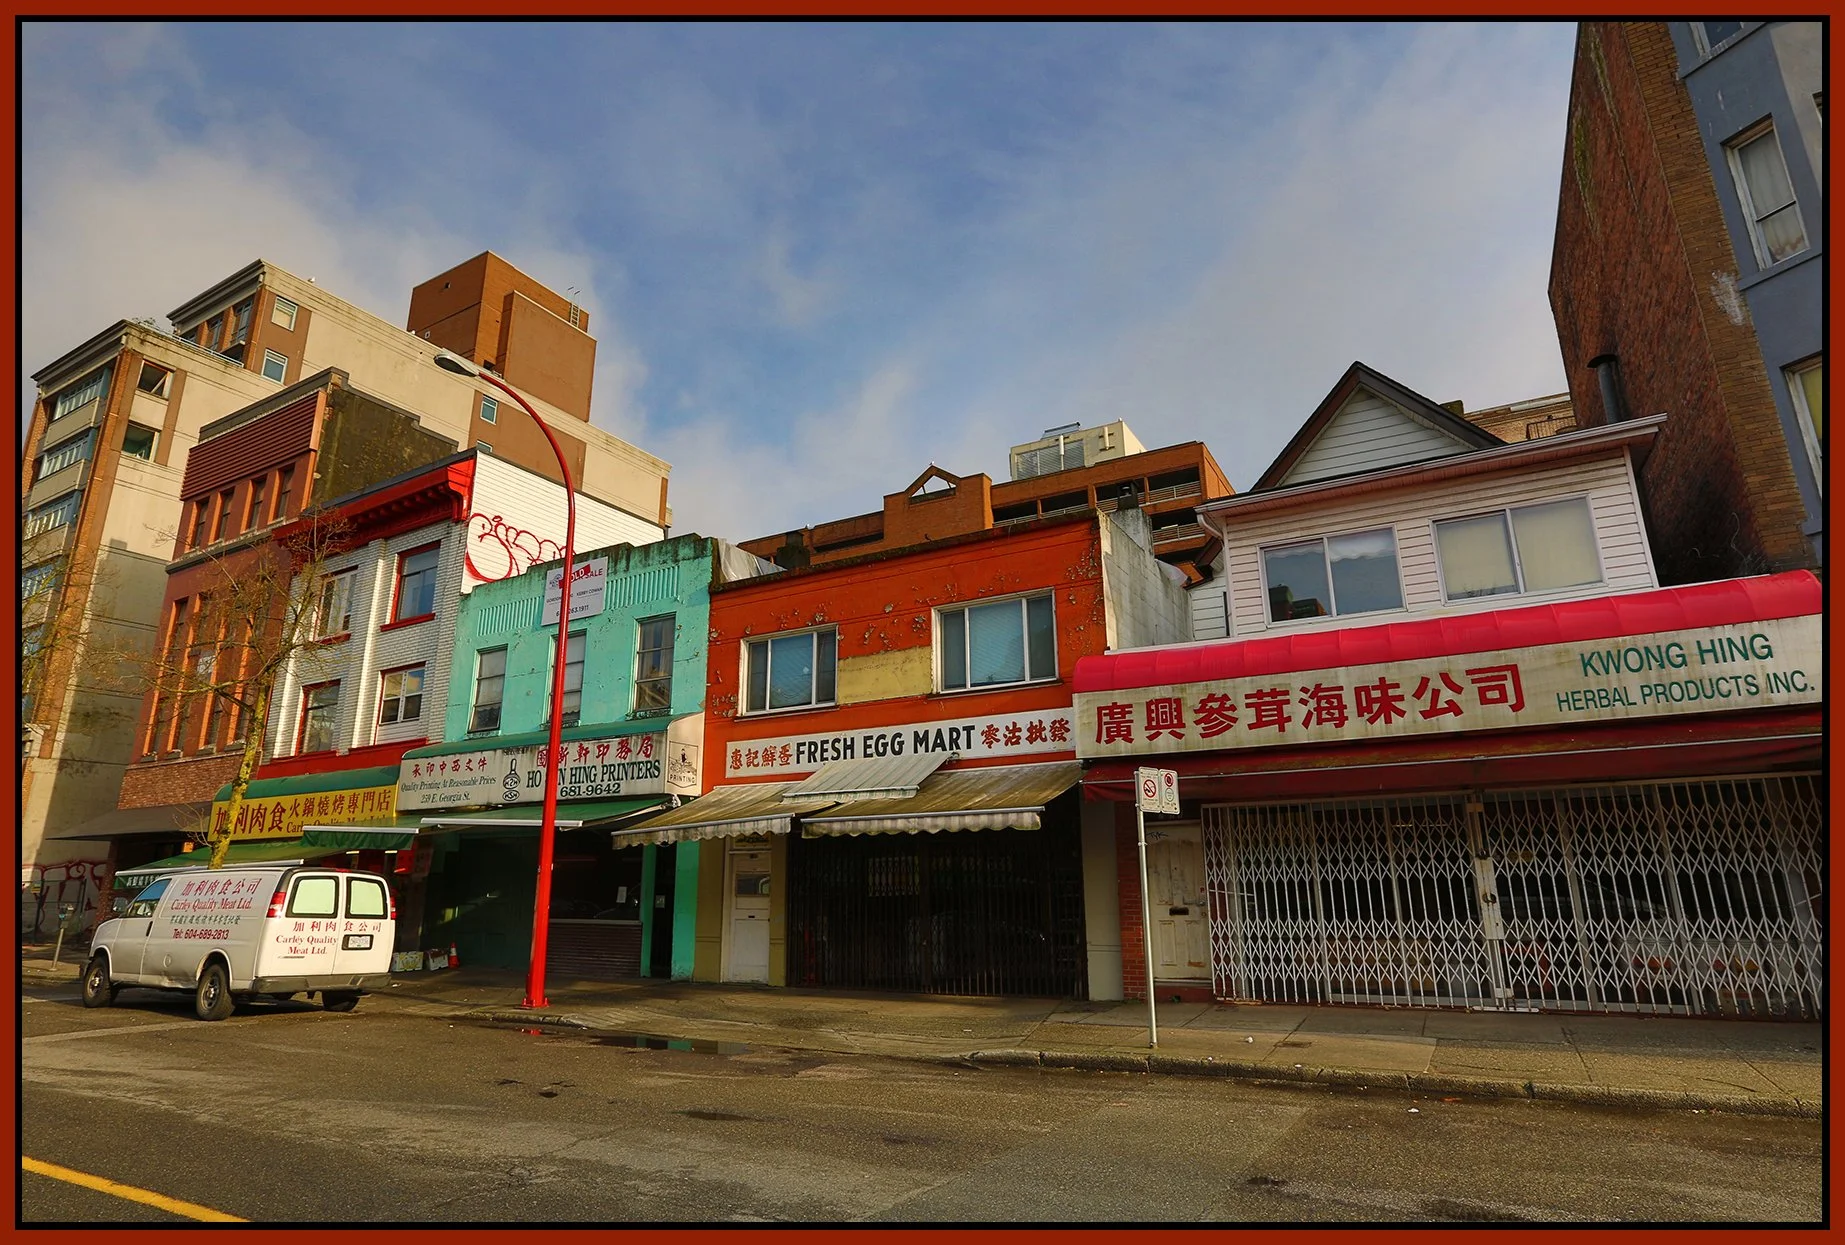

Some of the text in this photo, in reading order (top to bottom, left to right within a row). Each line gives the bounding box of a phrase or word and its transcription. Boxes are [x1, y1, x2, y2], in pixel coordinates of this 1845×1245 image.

[571, 568, 585, 581] OLD
[1580, 633, 1774, 677] KWONG HING
[1557, 670, 1816, 712] HERBAL PRODUCTS INC.
[981, 718, 1071, 749] 零沽批發
[796, 725, 976, 765] FRESH EGG MART
[526, 769, 542, 788] HO
[569, 764, 597, 785] HING
[600, 759, 661, 784] PRINTERS
[401, 782, 418, 792] Quality
[420, 780, 440, 790] Printing
[449, 776, 478, 788] Reasonable
[480, 775, 497, 785] Prices
[560, 782, 621, 798] 681-9642
[440, 792, 462, 803] Georgia
[171, 897, 252, 912] Carley Quality Meat Ltd.
[184, 928, 229, 940] 604-689-2813
[276, 935, 337, 945] Carley Quality
[288, 946, 327, 955] Meat Ltd.
